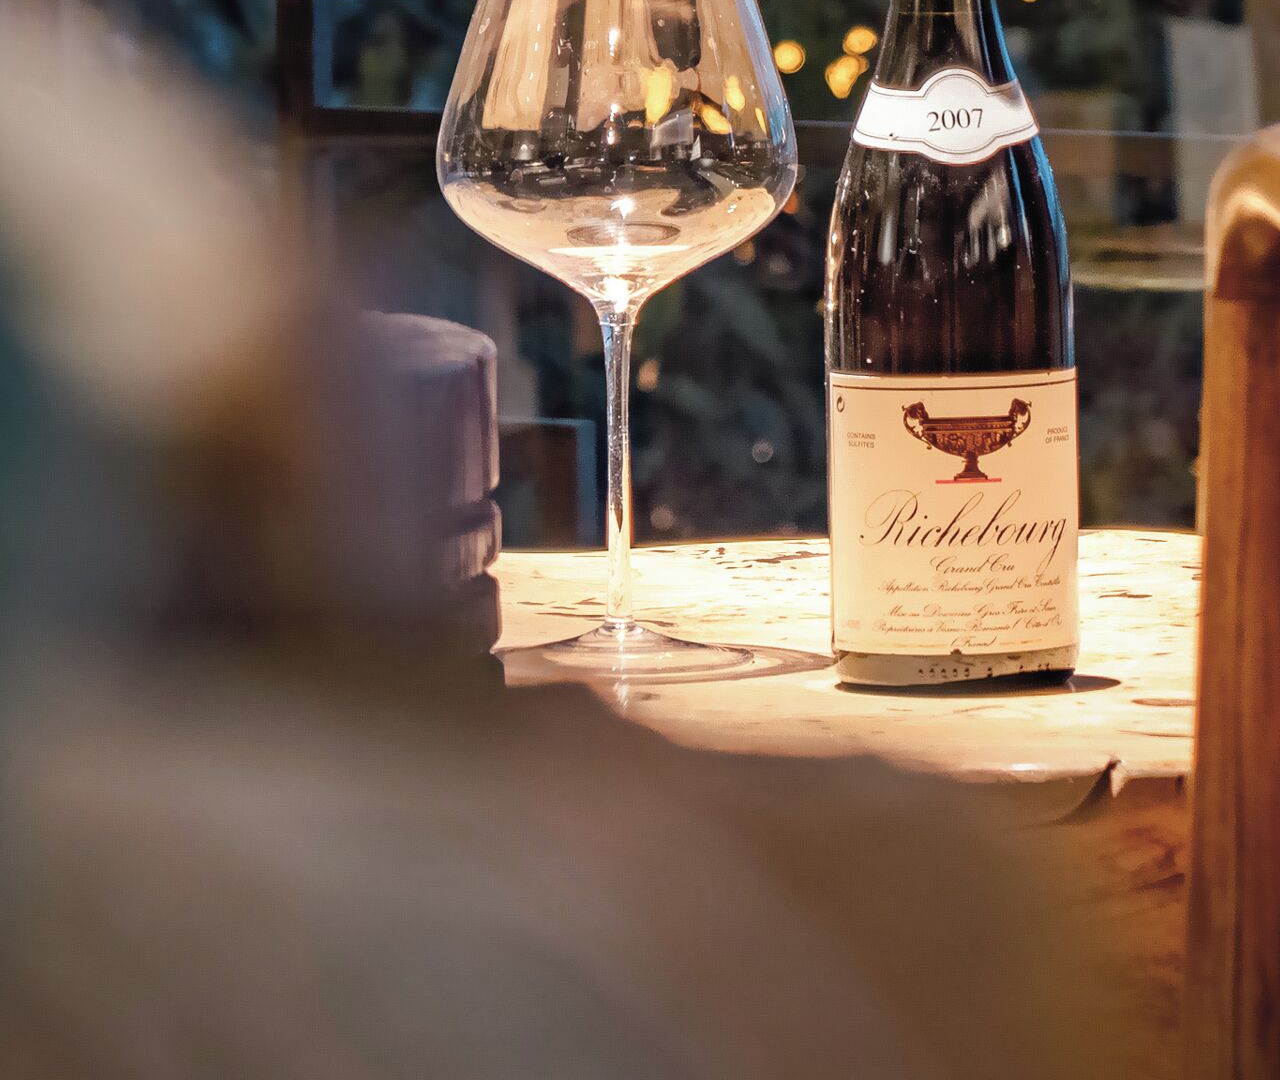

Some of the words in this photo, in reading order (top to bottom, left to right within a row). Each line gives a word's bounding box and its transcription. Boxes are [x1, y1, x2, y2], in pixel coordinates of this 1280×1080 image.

[927, 108, 984, 132] 2007
[859, 489, 1066, 572] Richebourg
[930, 555, 991, 574] Grand
[988, 553, 1015, 572] Cru
